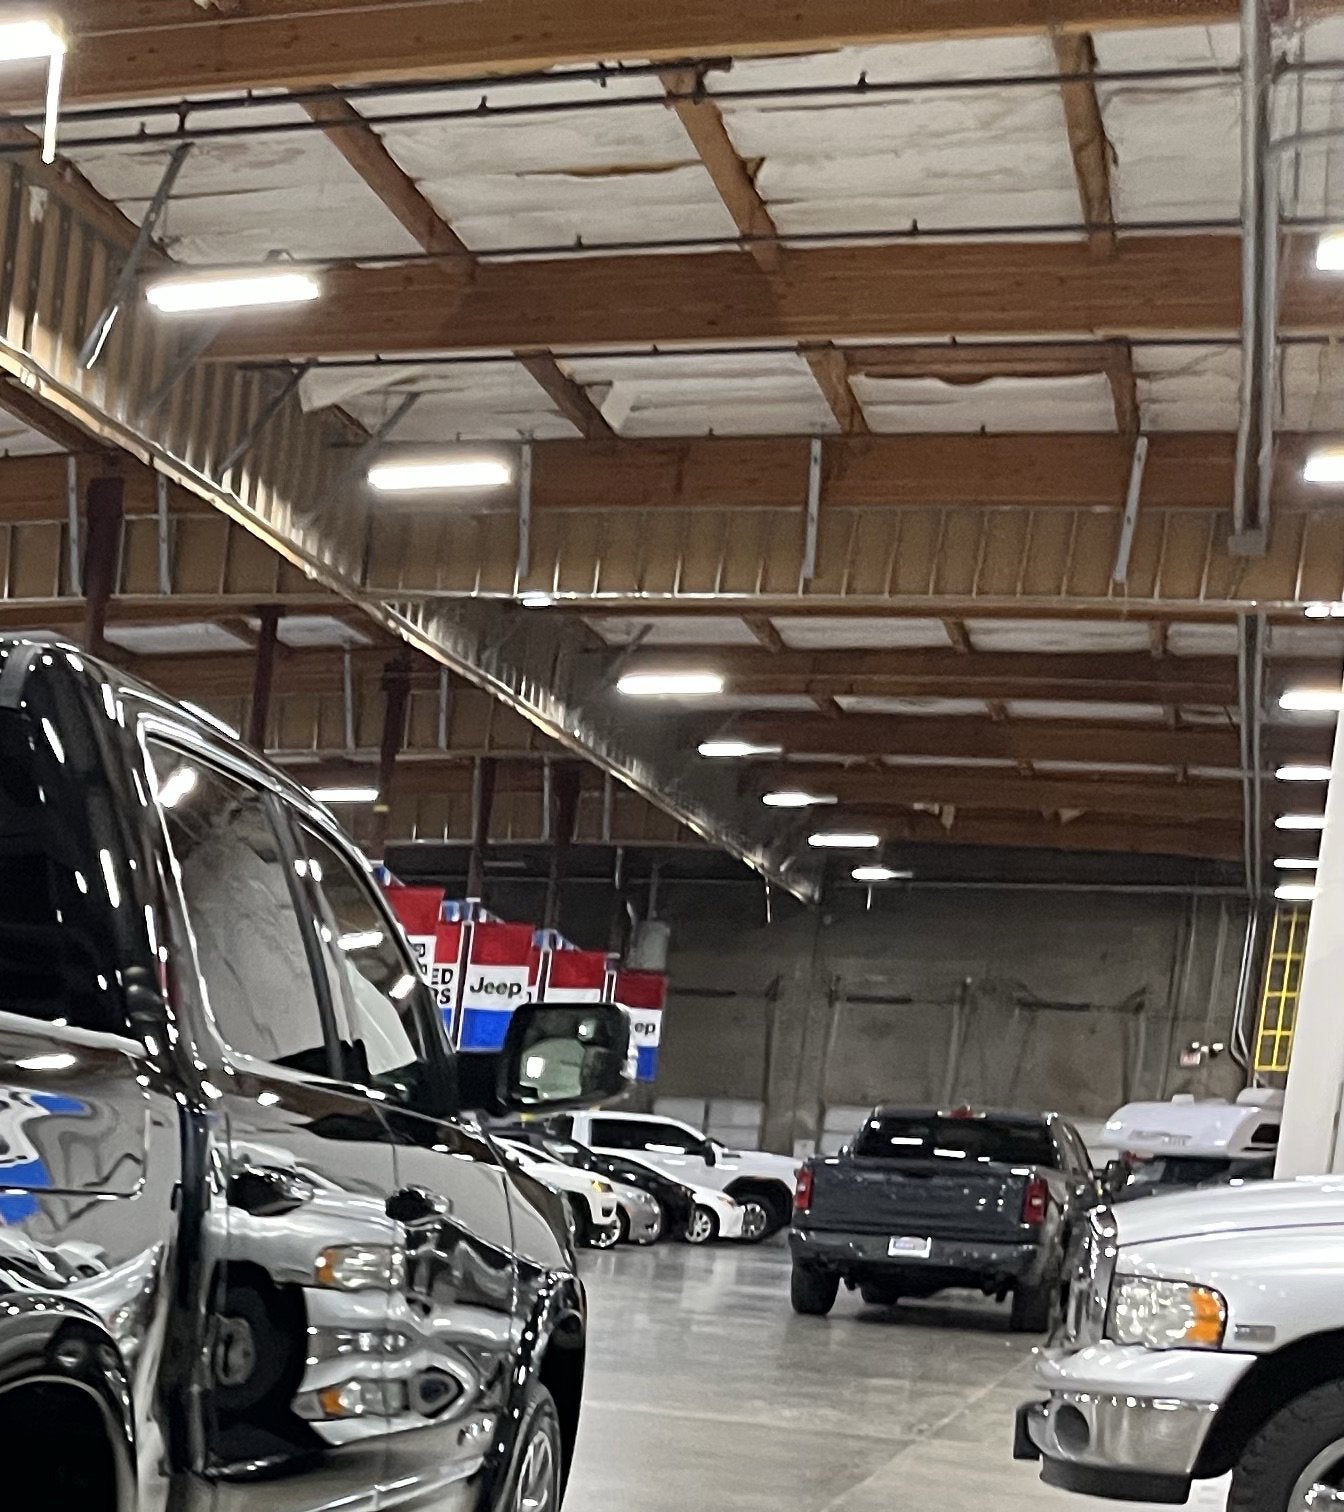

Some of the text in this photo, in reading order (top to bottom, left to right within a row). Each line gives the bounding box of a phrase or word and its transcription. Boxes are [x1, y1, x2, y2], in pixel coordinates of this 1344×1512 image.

[431, 968, 454, 985] ED
[470, 977, 522, 999] Jeep
[634, 1022, 656, 1036] ep
